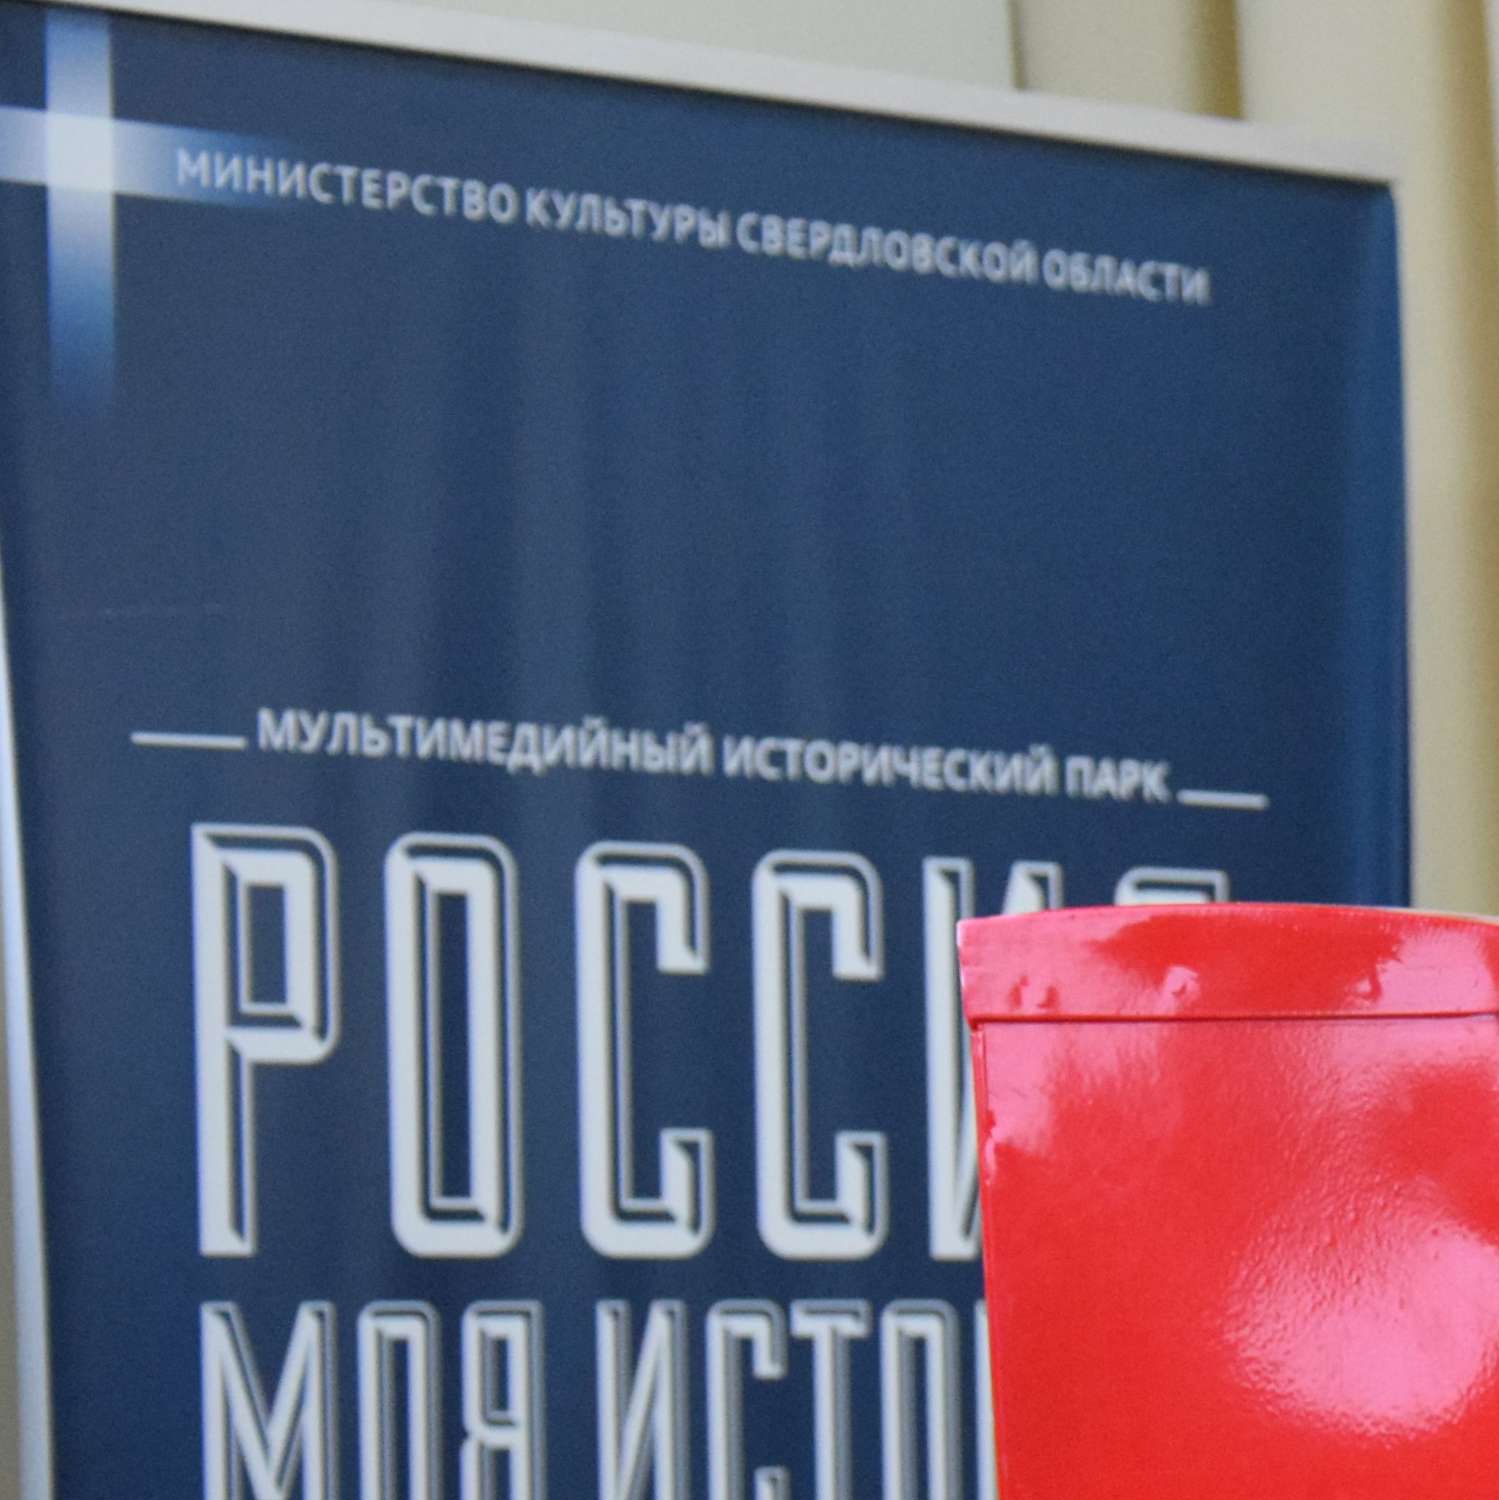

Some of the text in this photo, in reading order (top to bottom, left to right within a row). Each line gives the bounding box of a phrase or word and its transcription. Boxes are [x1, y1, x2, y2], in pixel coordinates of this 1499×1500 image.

[176, 146, 1212, 306] МИНИСТЕРСТВО КУЛЬТУРЫ СВЕРДЛОВСКОЙ ОБЛАСТИ
[256, 708, 1171, 802] МУЛЬТИМЕДИЙНЫЙ ИСТОРИЧЕСКИЙ ПАРК
